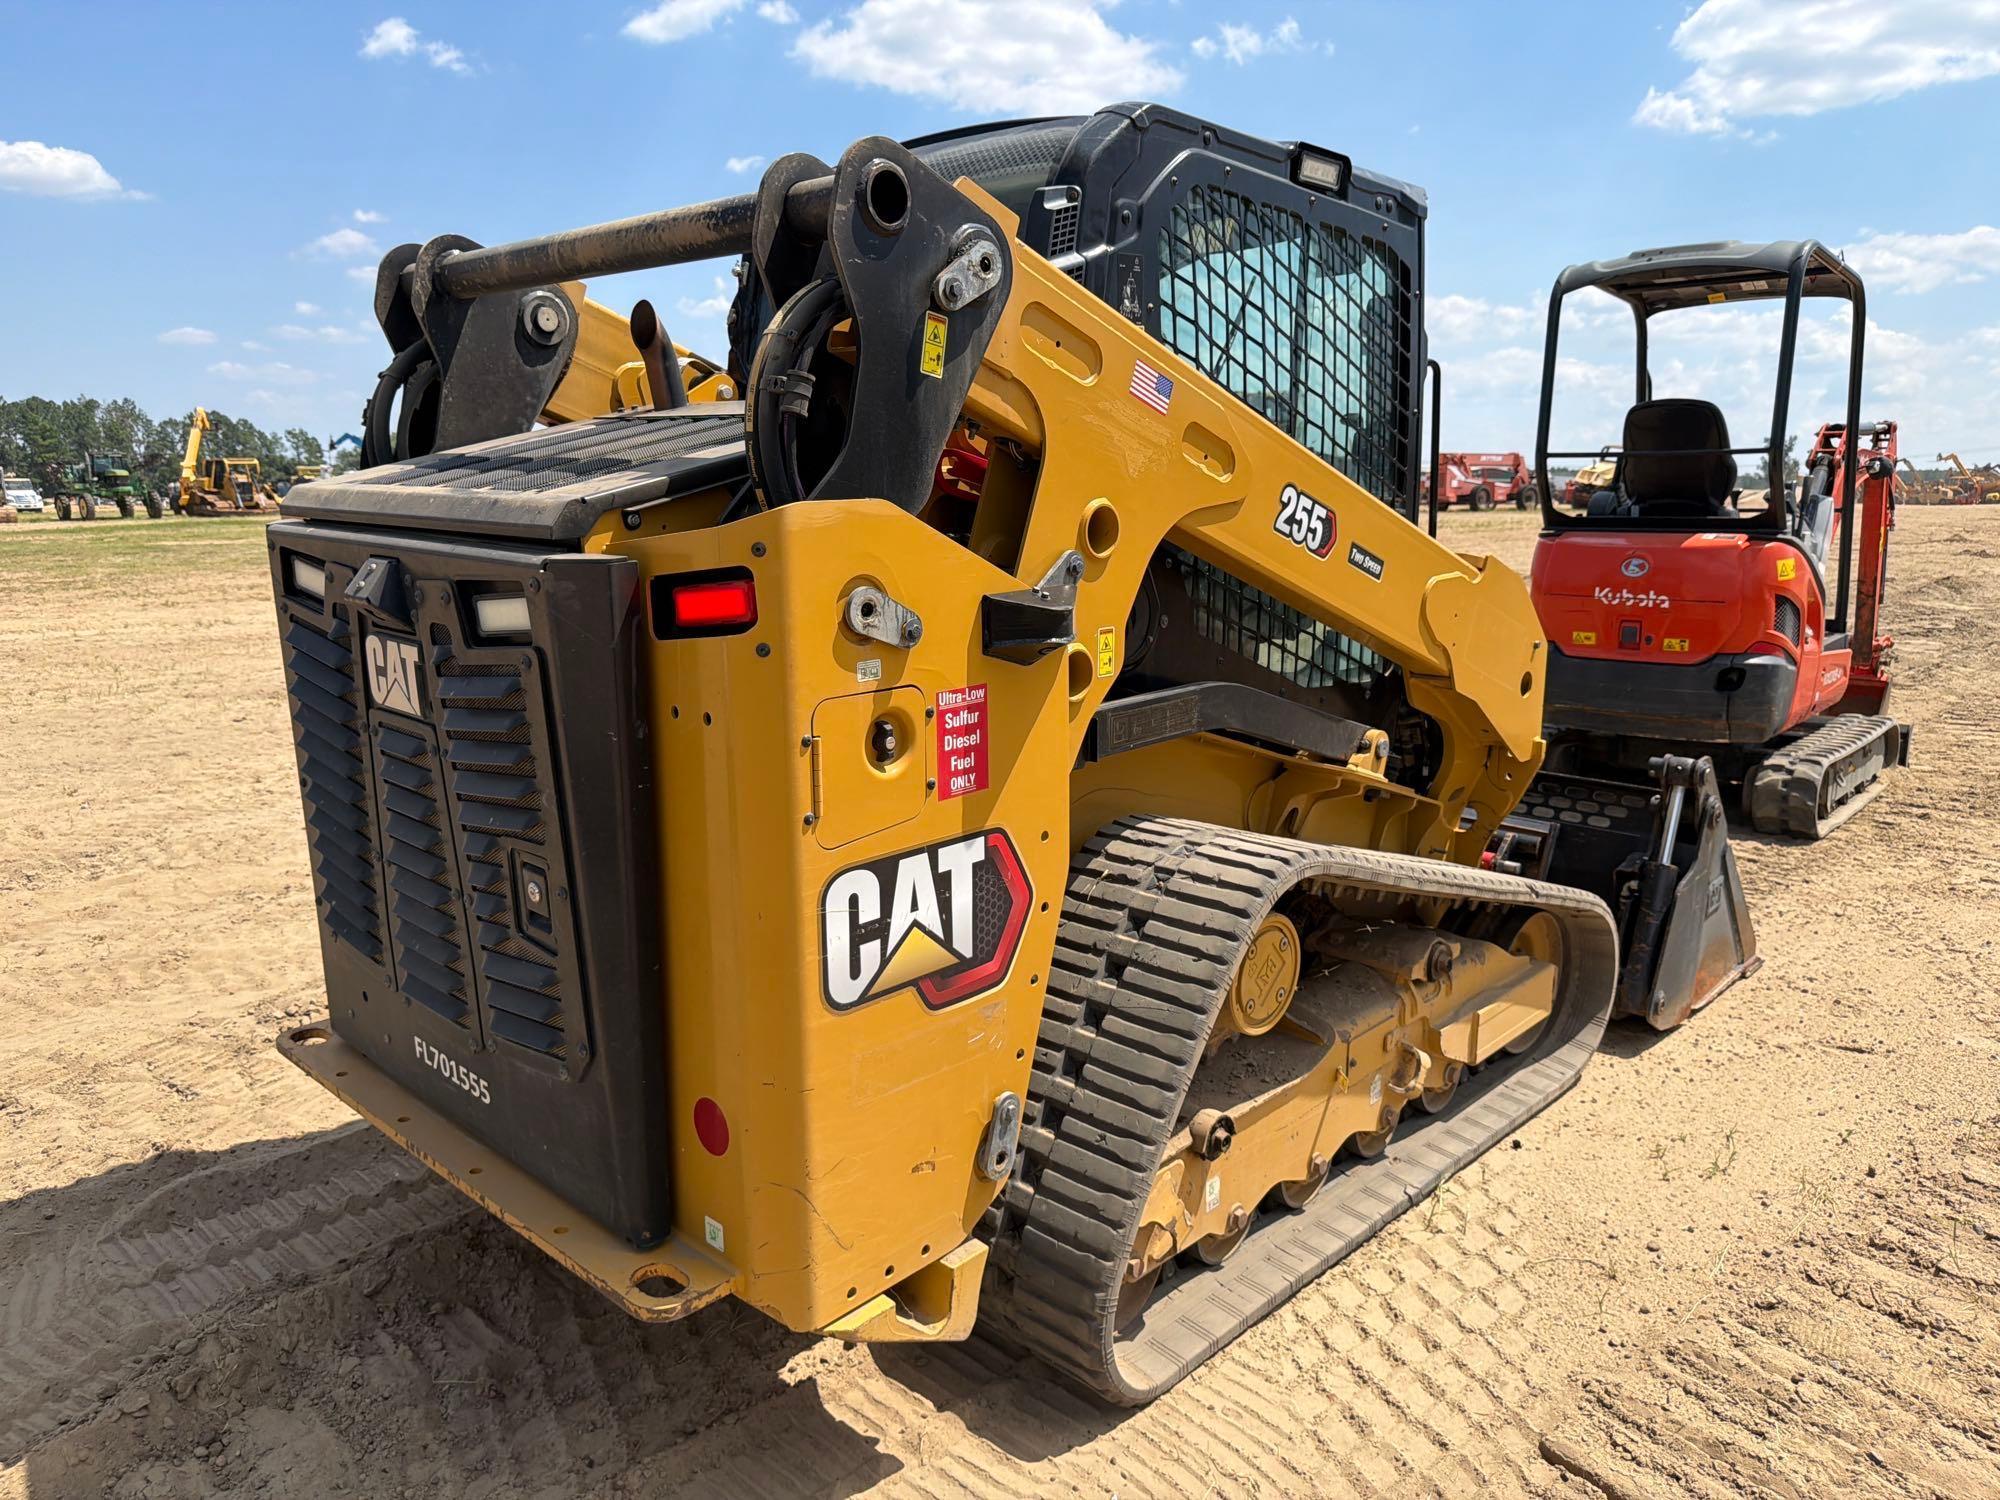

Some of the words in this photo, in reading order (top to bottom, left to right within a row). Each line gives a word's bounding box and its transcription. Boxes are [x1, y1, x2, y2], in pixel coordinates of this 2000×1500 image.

[1275, 486, 1327, 550] 255
[1594, 587, 1670, 608] Kubota
[366, 635, 421, 716] CAT
[938, 688, 985, 707] Ultra-Low
[944, 709, 979, 729] Sulfur
[944, 729, 980, 751] Diesel
[950, 752, 975, 772] Fuel
[950, 773, 976, 791] ONLY
[826, 836, 985, 1004] CAT
[414, 1035, 491, 1104] FL701555
